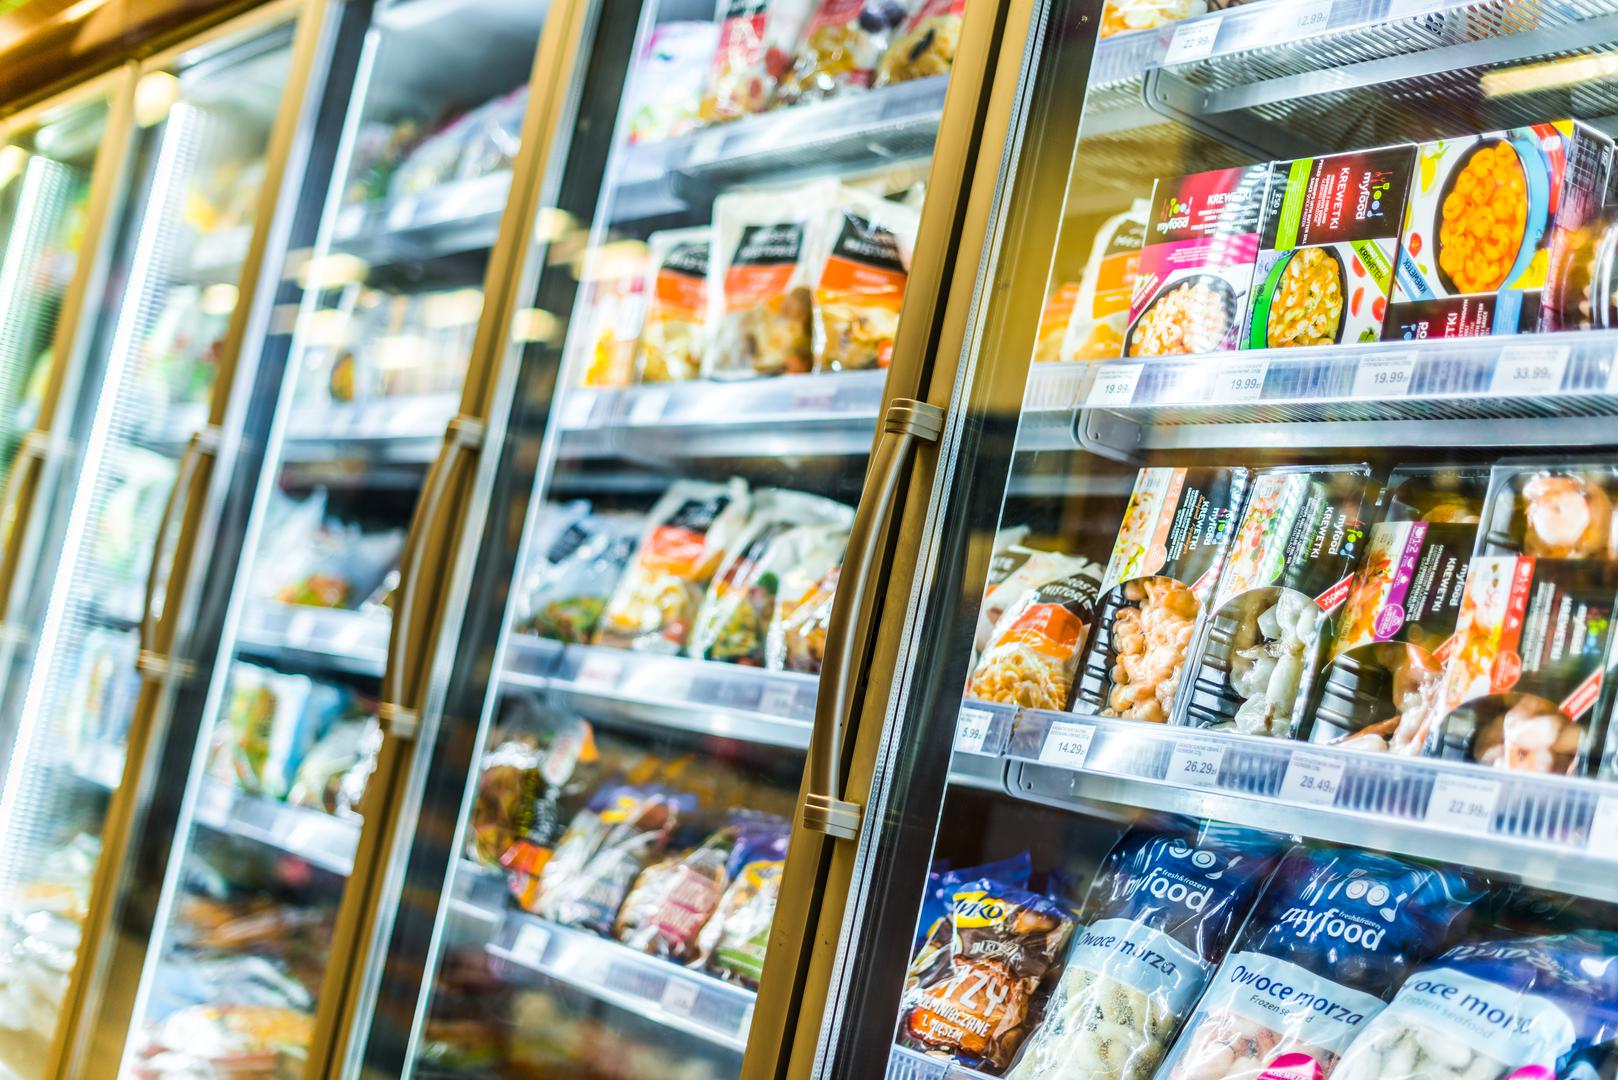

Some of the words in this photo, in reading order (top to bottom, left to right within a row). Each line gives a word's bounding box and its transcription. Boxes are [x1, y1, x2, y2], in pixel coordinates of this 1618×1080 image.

[1207, 192, 1254, 205] KREWKI
[1330, 167, 1350, 229] KREWETKI
[1356, 172, 1372, 220] myfood
[1157, 216, 1190, 235] myfood
[1359, 246, 1384, 282] KREWETEK
[1189, 501, 1210, 550] KREWETKI
[1203, 508, 1220, 545] myfood
[1310, 506, 1334, 558] KREWETKI
[1328, 514, 1347, 555] myfood
[1432, 557, 1458, 611] KREWETKI
[1450, 564, 1468, 606] myfood
[1123, 867, 1214, 913] myfood
[1162, 869, 1208, 891] fresh&frozen
[1078, 932, 1117, 950] Owoce
[1280, 907, 1386, 951] myfood
[1339, 911, 1382, 930] fresh&frozen
[1231, 965, 1294, 1001] Owoce
[1294, 991, 1364, 1026] morza
[1250, 995, 1279, 1016] Frozen
